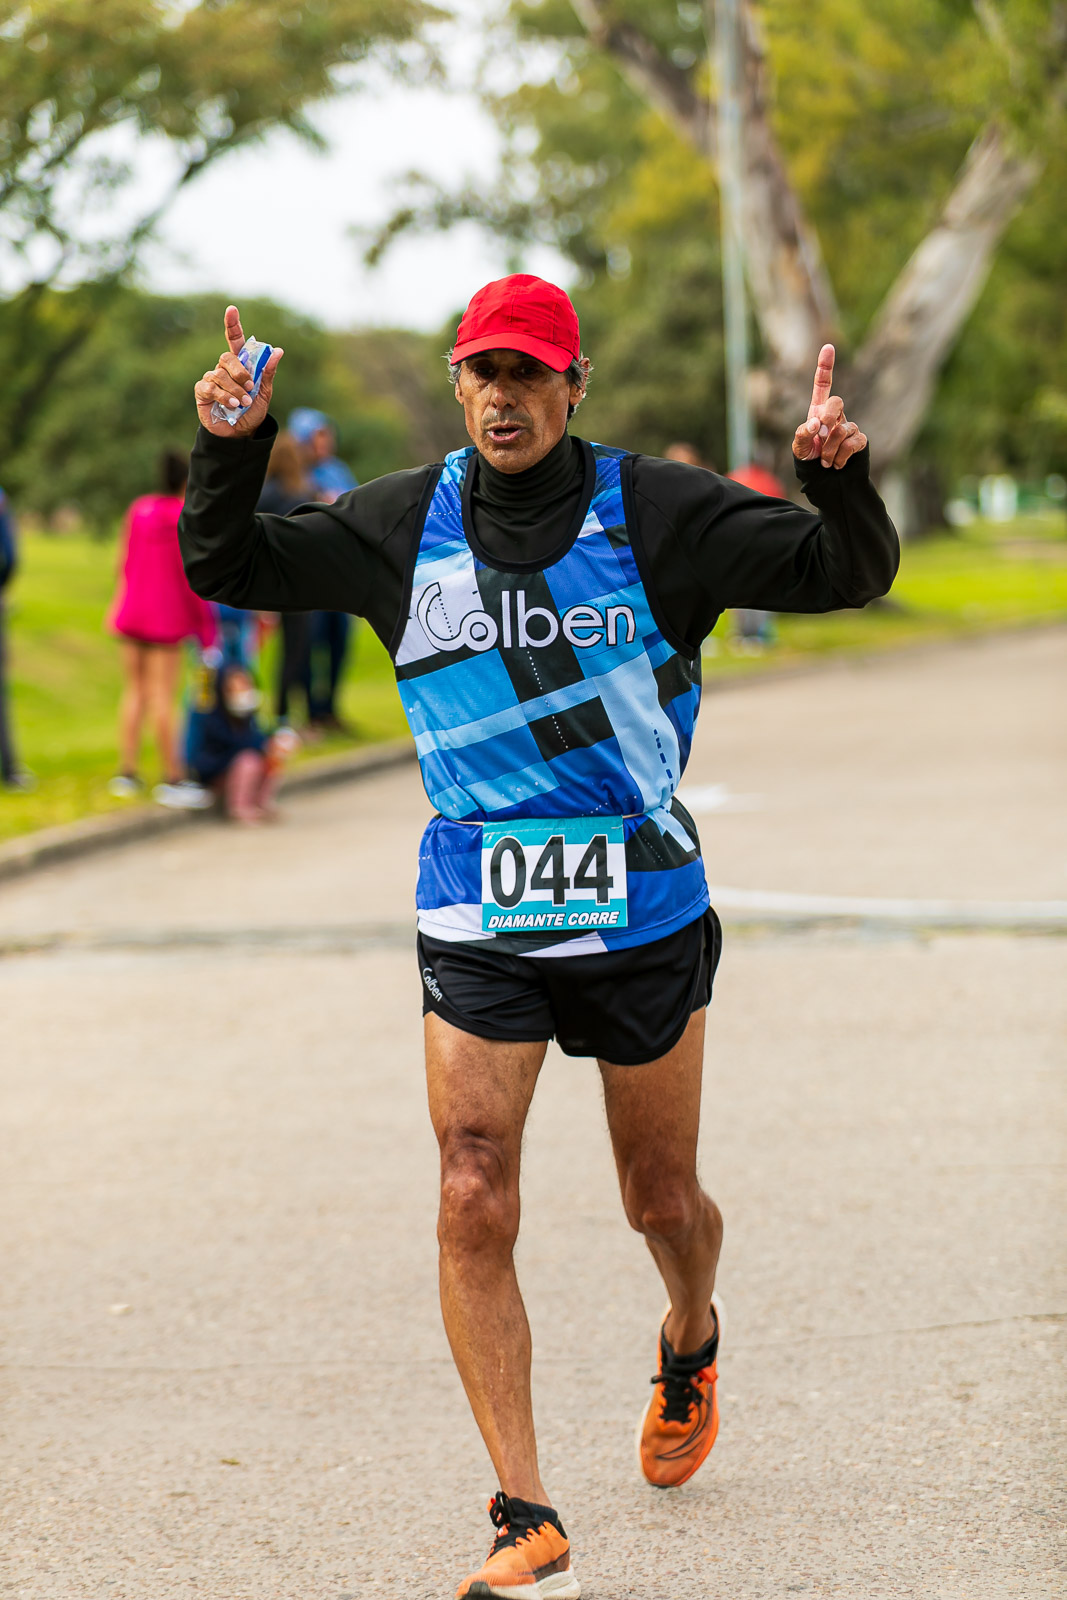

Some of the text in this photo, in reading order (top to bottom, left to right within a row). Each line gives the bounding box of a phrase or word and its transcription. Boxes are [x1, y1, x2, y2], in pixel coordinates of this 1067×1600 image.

[417, 581, 636, 651] Colben
[490, 834, 614, 908] 044
[487, 911, 620, 929] DIAMANTE CORRE
[422, 967, 443, 1002] Colben
